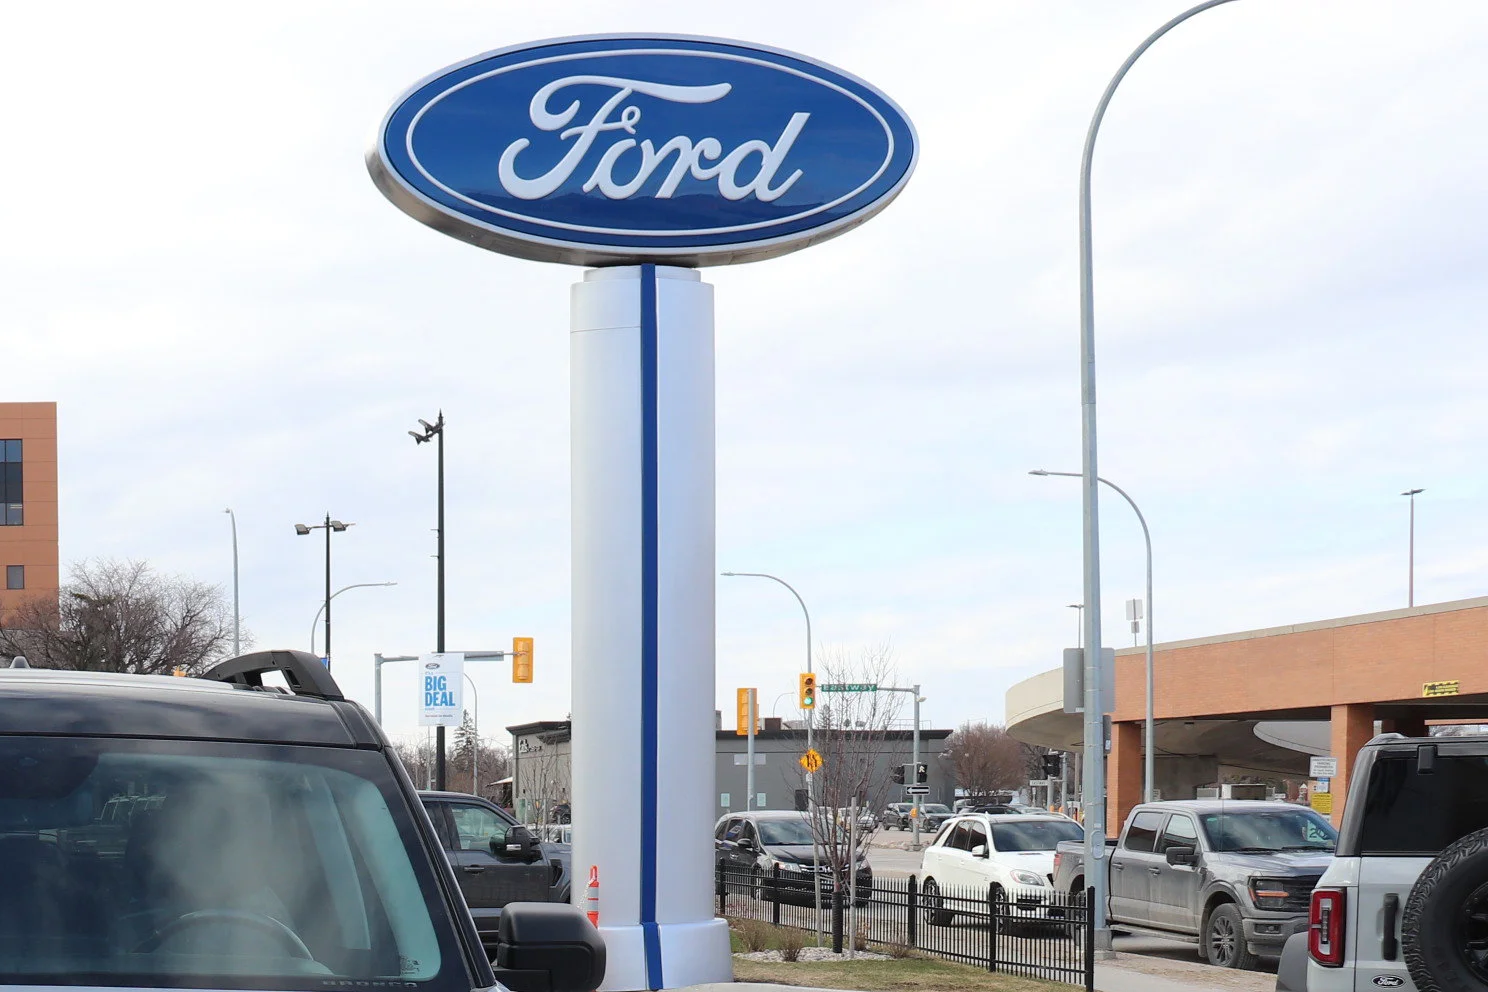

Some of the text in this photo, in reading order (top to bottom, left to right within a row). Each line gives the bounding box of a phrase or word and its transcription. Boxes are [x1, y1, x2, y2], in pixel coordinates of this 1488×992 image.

[498, 75, 810, 203] Ford
[425, 675, 447, 692] BIG
[425, 691, 456, 707] DEAL
[1377, 976, 1400, 986] Ford
